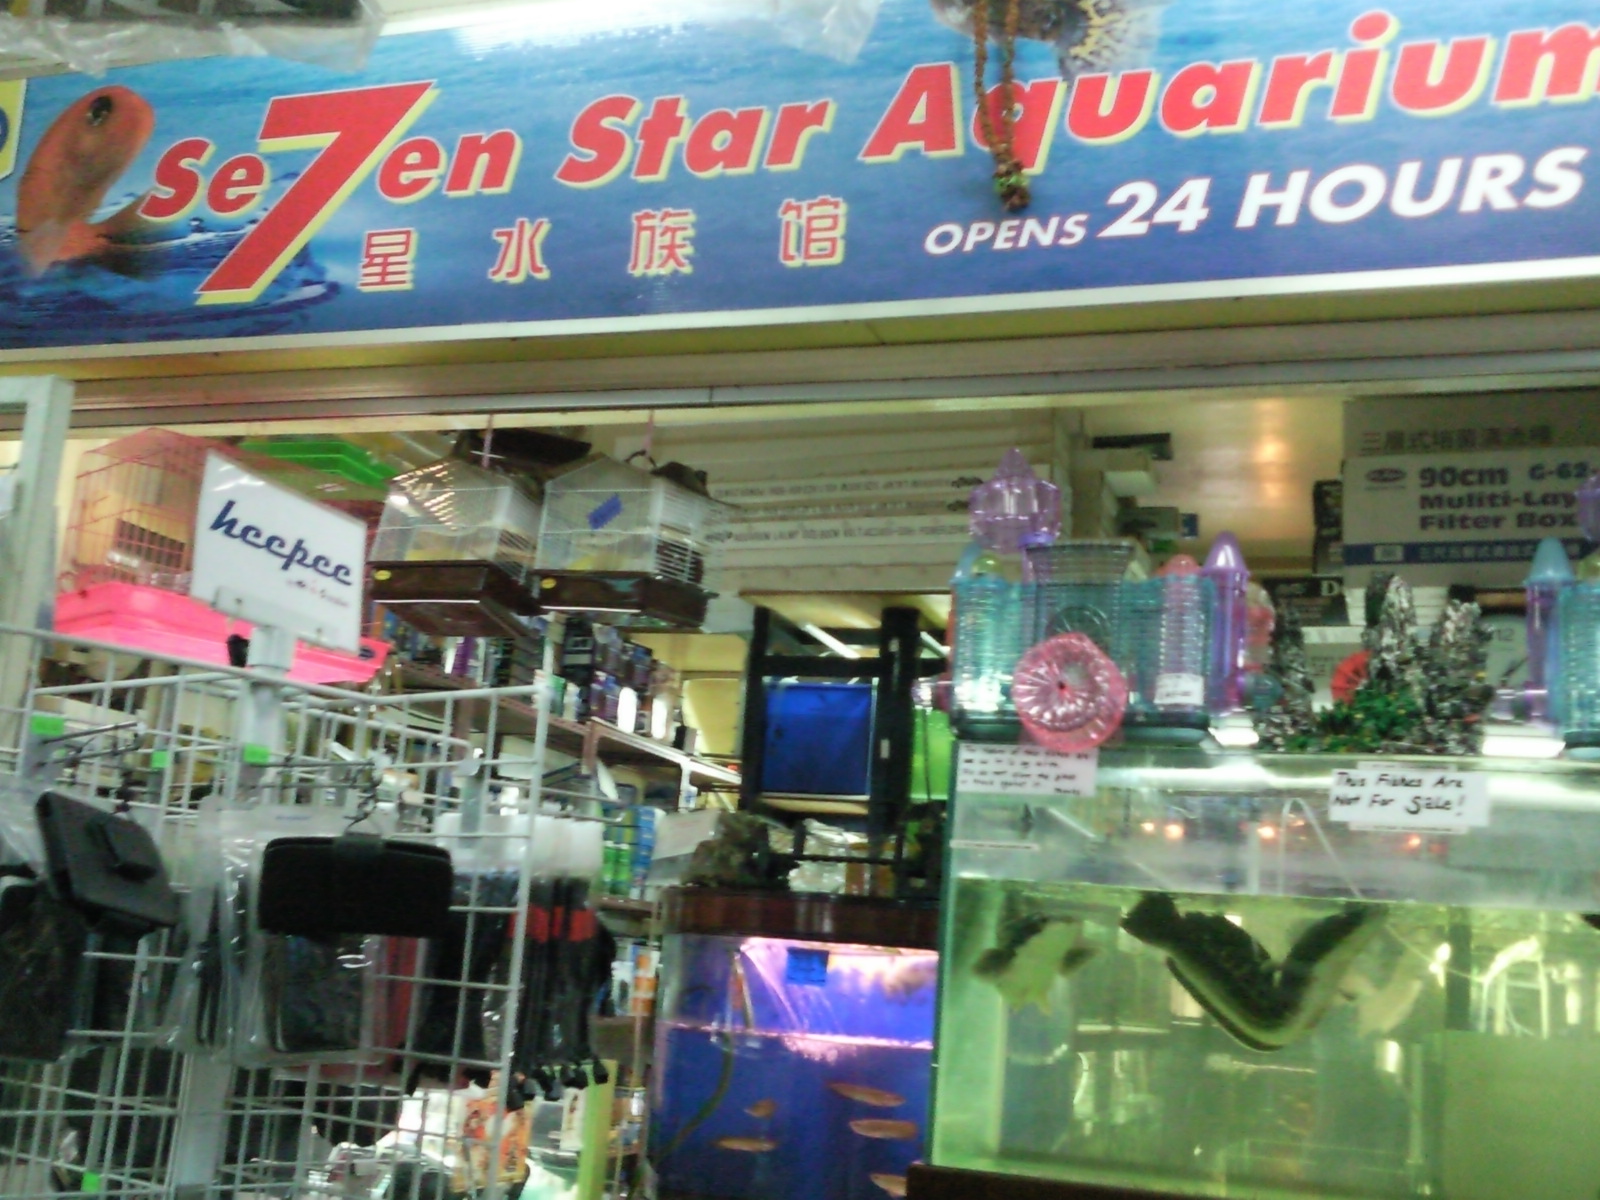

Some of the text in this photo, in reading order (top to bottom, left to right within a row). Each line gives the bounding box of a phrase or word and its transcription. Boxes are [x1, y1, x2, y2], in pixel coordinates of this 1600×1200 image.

[138, 11, 1600, 304] Se7en Star Aquarium
[923, 147, 1588, 256] OPENS 24 HOURS
[1419, 466, 1508, 487] 90cm
[1419, 512, 1578, 530] Filter Box
